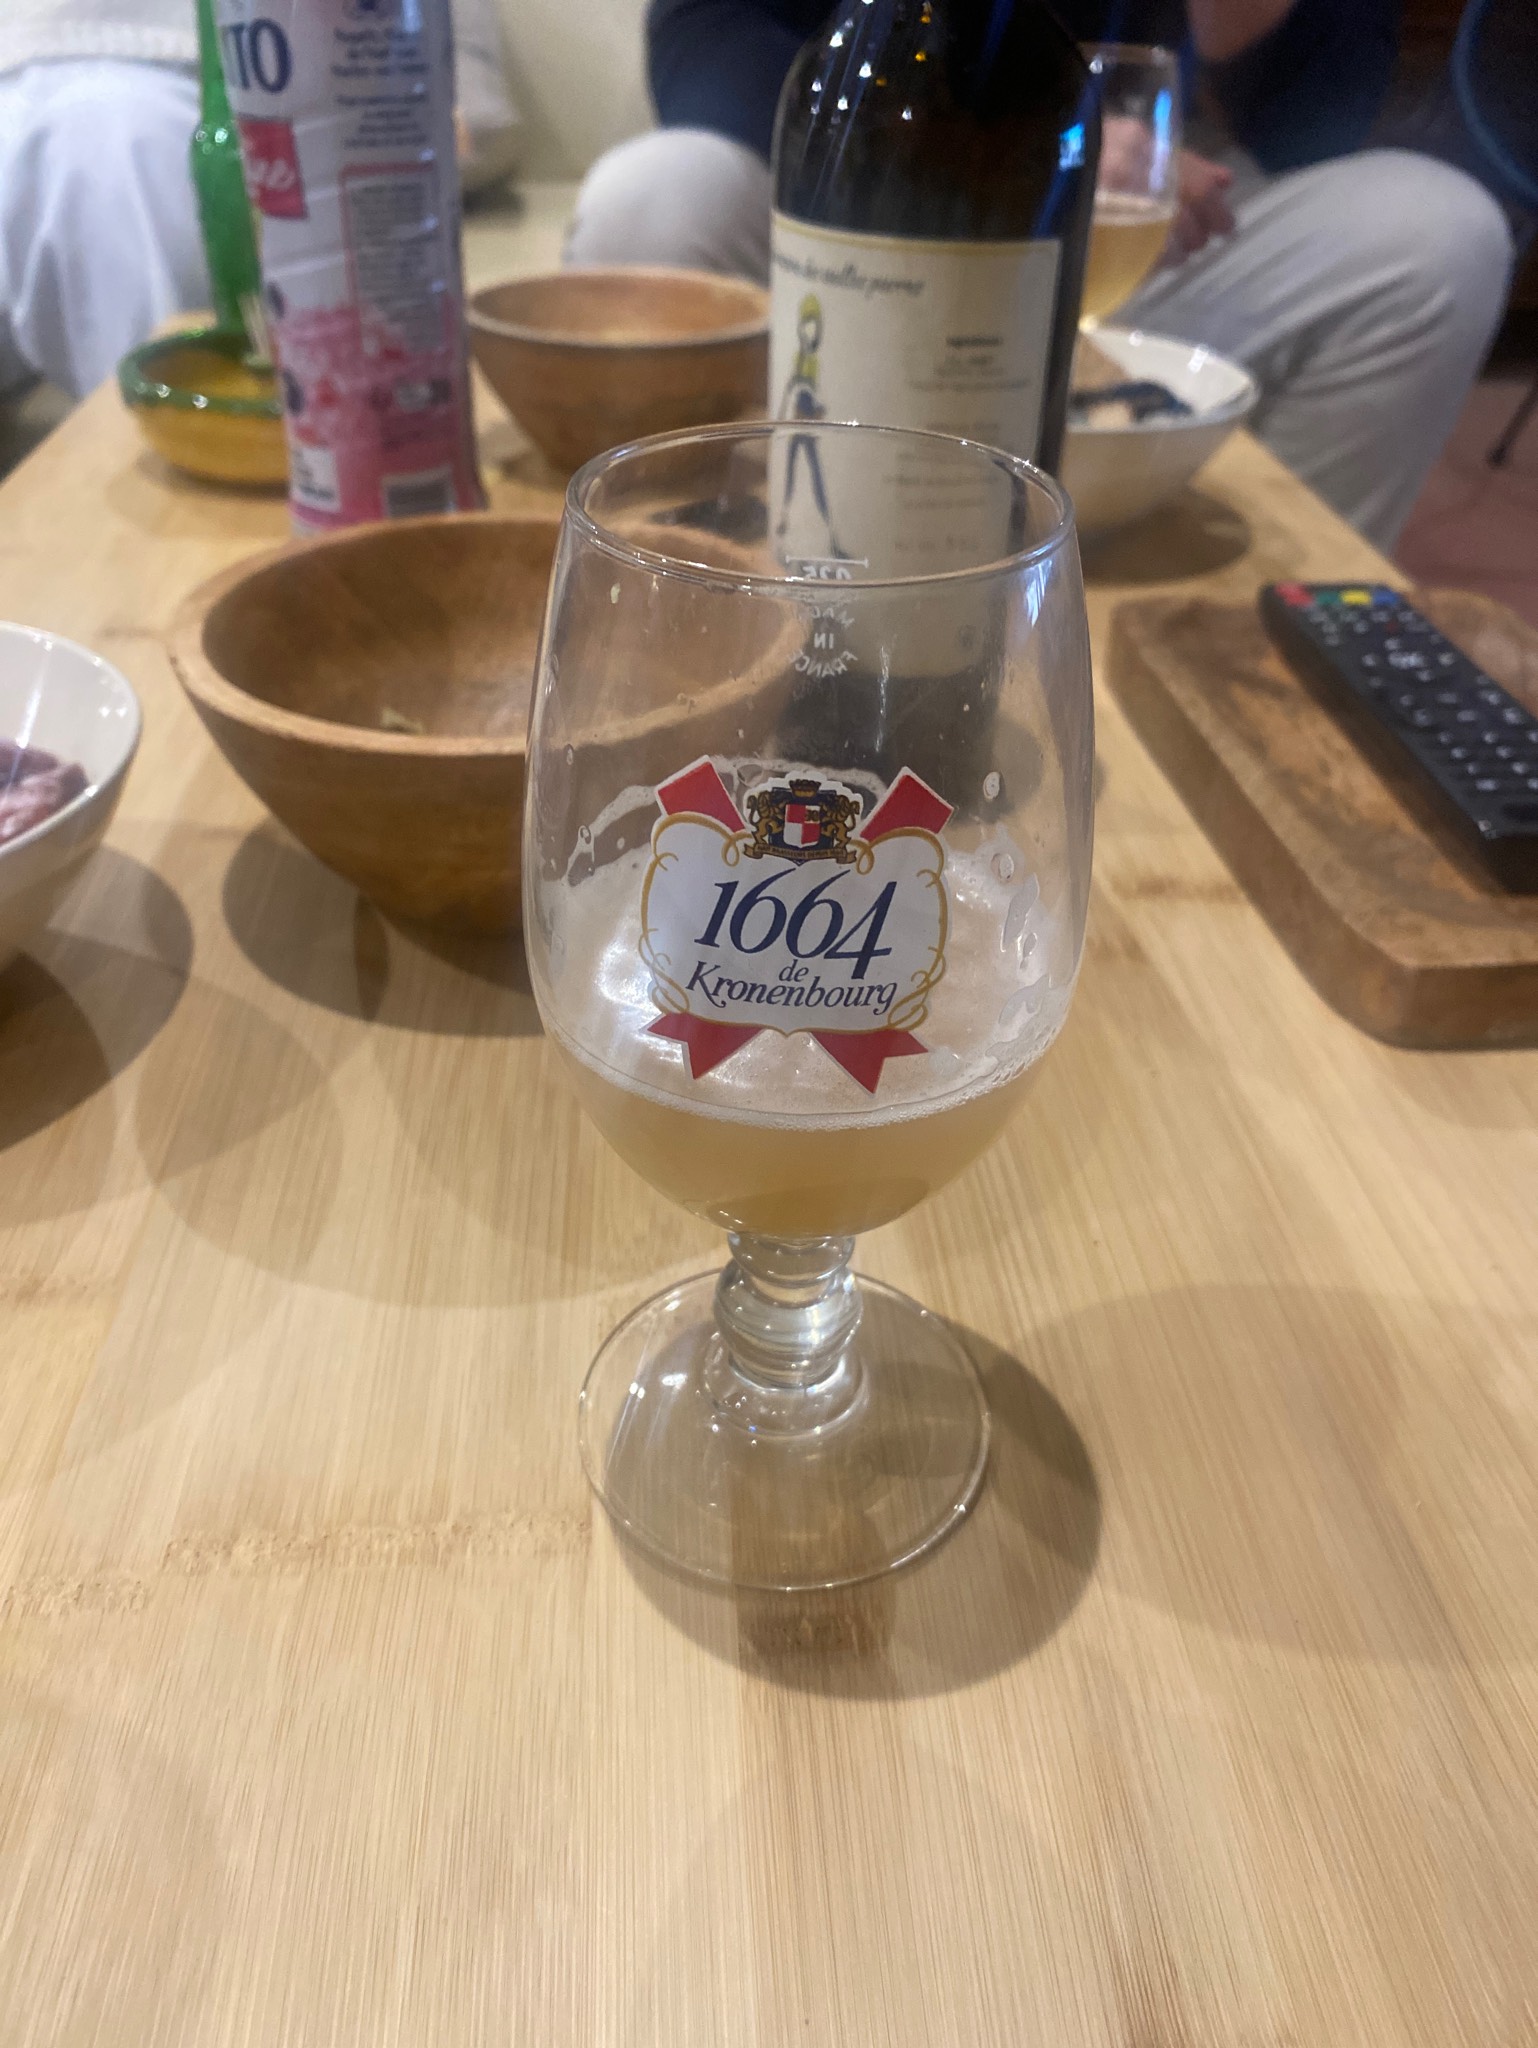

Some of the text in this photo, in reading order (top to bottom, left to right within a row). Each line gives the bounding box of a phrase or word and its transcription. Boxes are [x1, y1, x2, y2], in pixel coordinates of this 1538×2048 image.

[693, 867, 898, 980] 1664
[685, 960, 898, 1015] Kronenbourg
[778, 958, 809, 982] de
